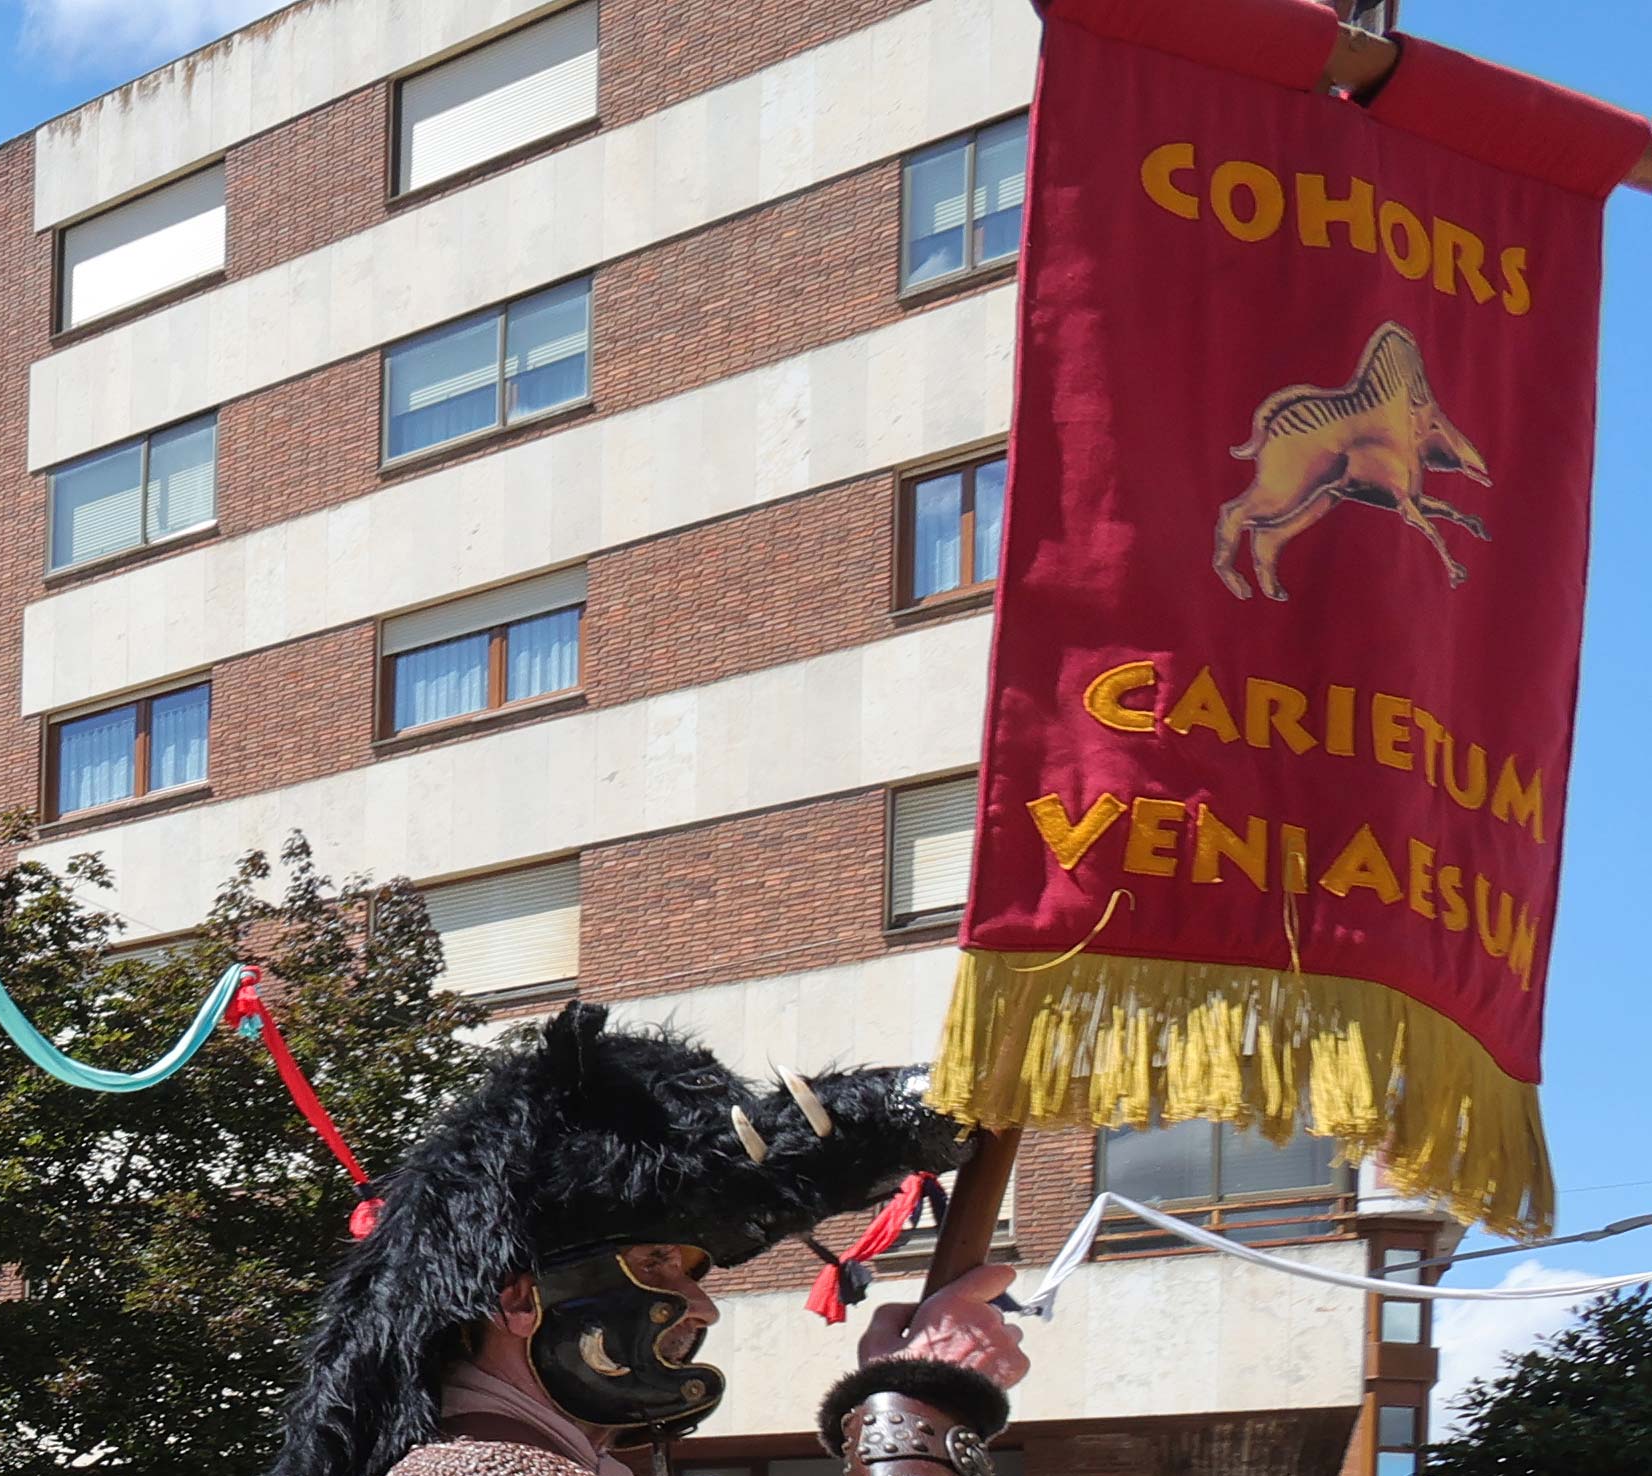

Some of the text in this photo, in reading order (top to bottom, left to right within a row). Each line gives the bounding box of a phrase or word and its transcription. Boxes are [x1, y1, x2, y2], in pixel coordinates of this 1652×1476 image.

[1141, 143, 1531, 316] COHORS
[1084, 660, 1544, 844] CARIETUM
[1026, 793, 1538, 991] VENIAESUM
